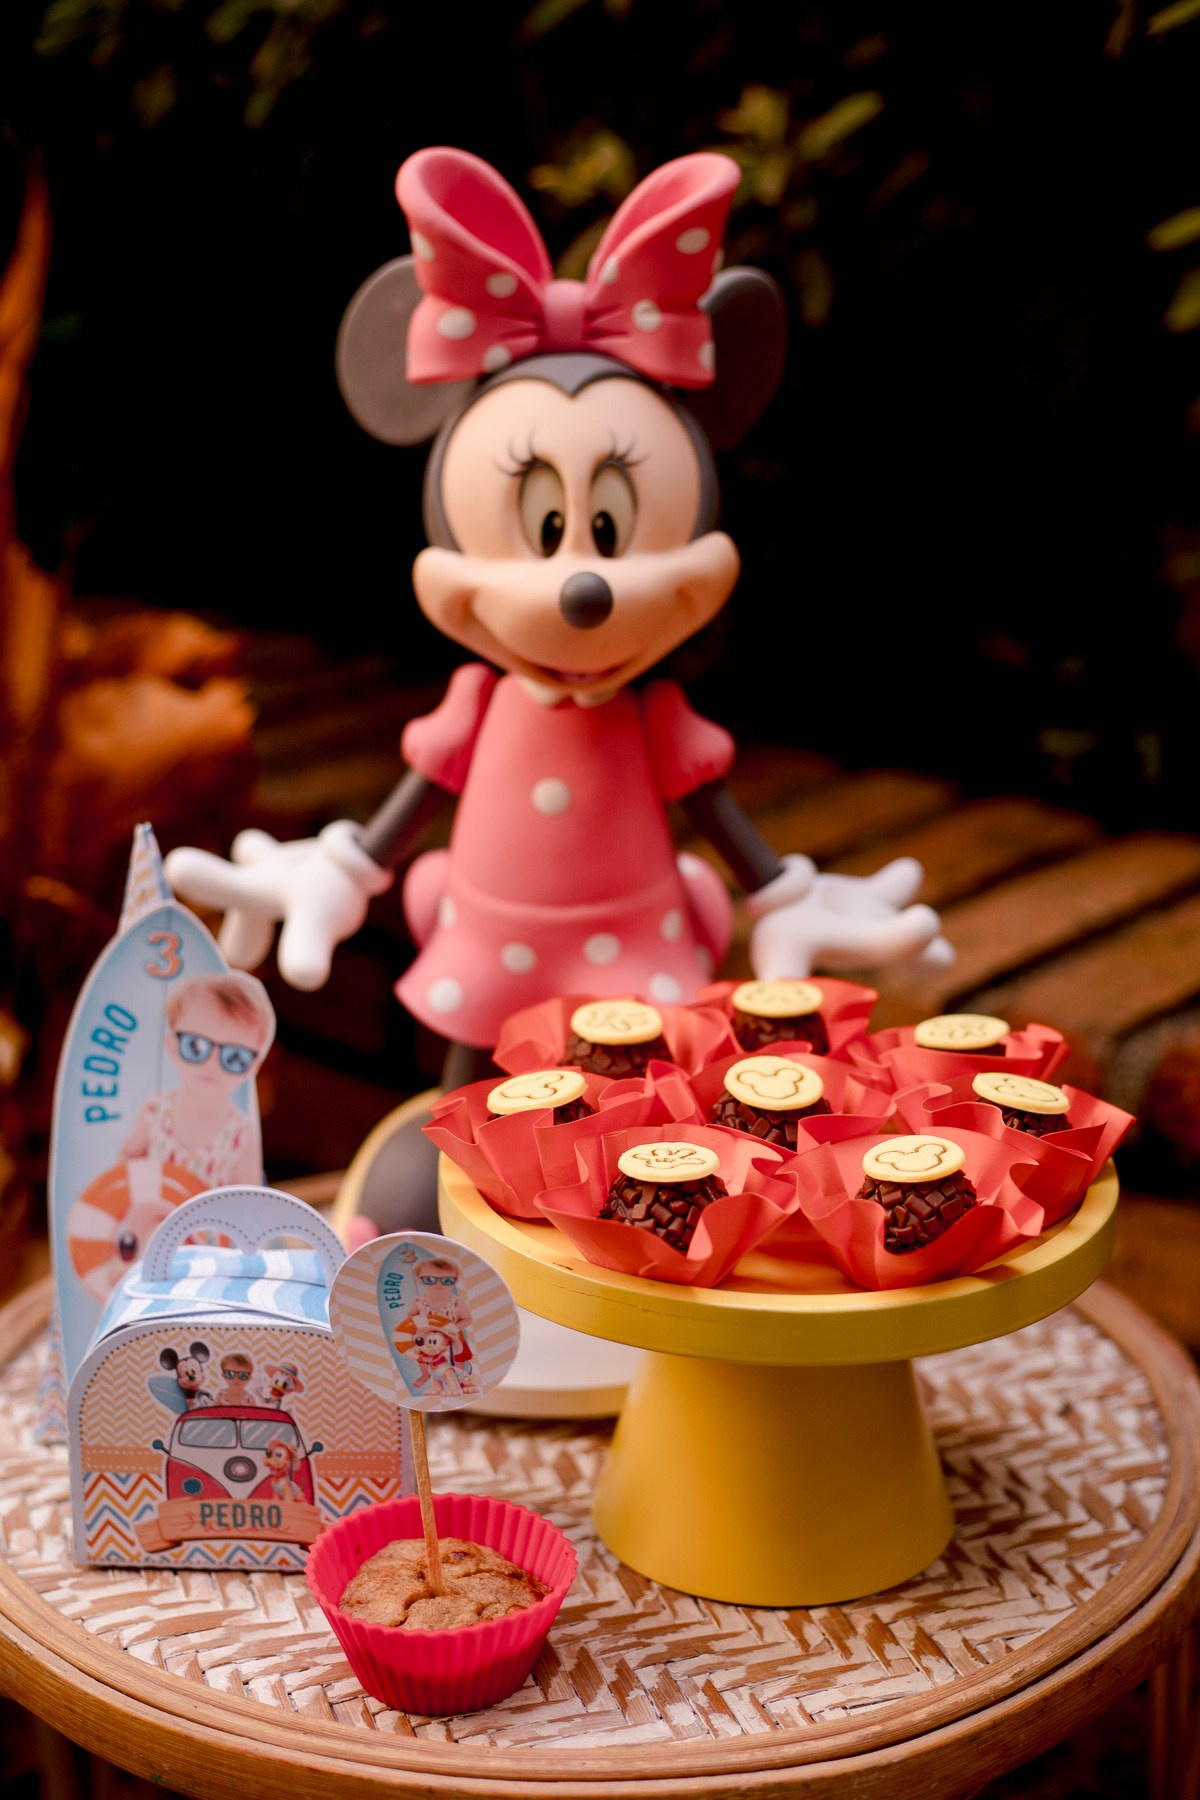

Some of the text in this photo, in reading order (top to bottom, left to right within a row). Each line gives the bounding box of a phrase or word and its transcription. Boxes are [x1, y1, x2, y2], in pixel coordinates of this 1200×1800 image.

[146, 931, 183, 979] 3
[82, 1003, 138, 1123] PEDRO
[399, 1249, 417, 1264] 3
[383, 1272, 405, 1309] PEDRO
[200, 1502, 282, 1528] PEDRO
